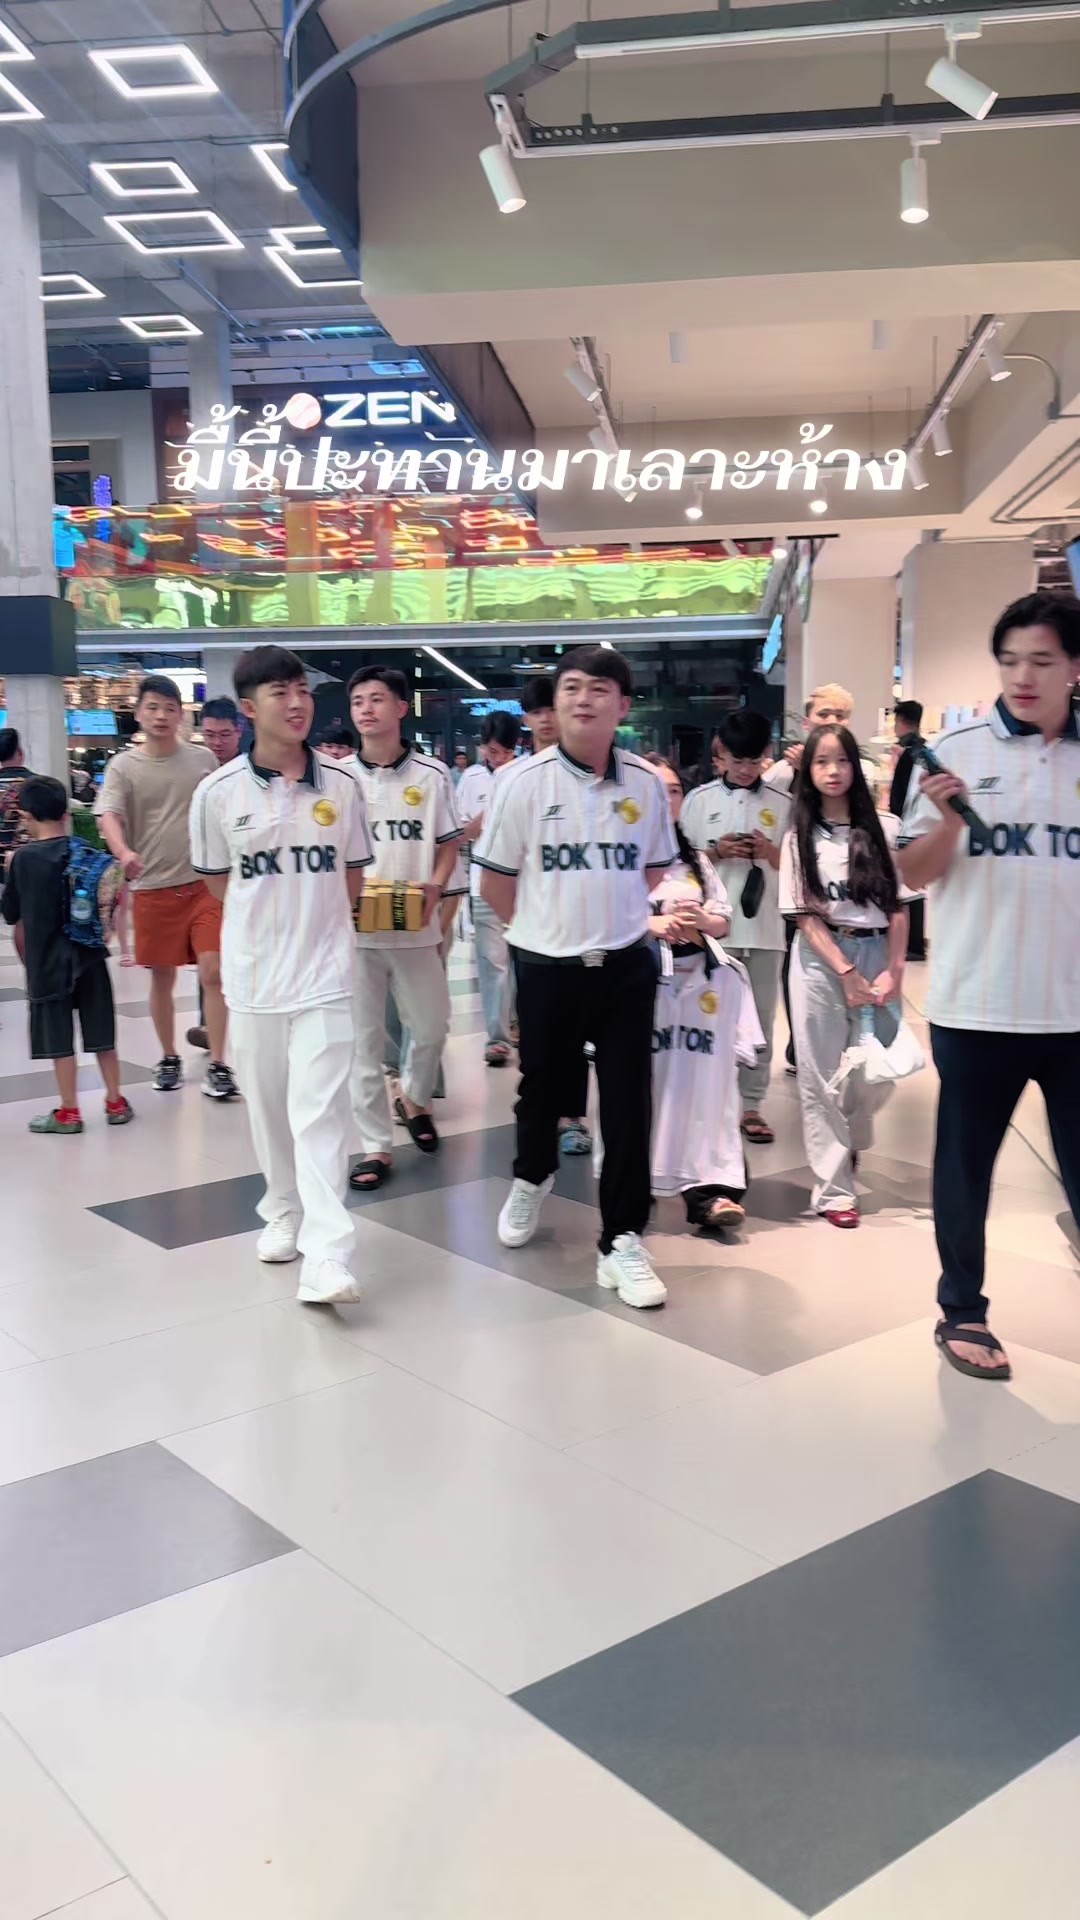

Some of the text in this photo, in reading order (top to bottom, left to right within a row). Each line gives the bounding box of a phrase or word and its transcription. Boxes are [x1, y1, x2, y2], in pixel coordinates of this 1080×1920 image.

[323, 390, 456, 427] ZEN
[386, 820, 424, 841] TOR
[240, 845, 337, 879] BOK TOR
[541, 842, 640, 872] BOK TOR
